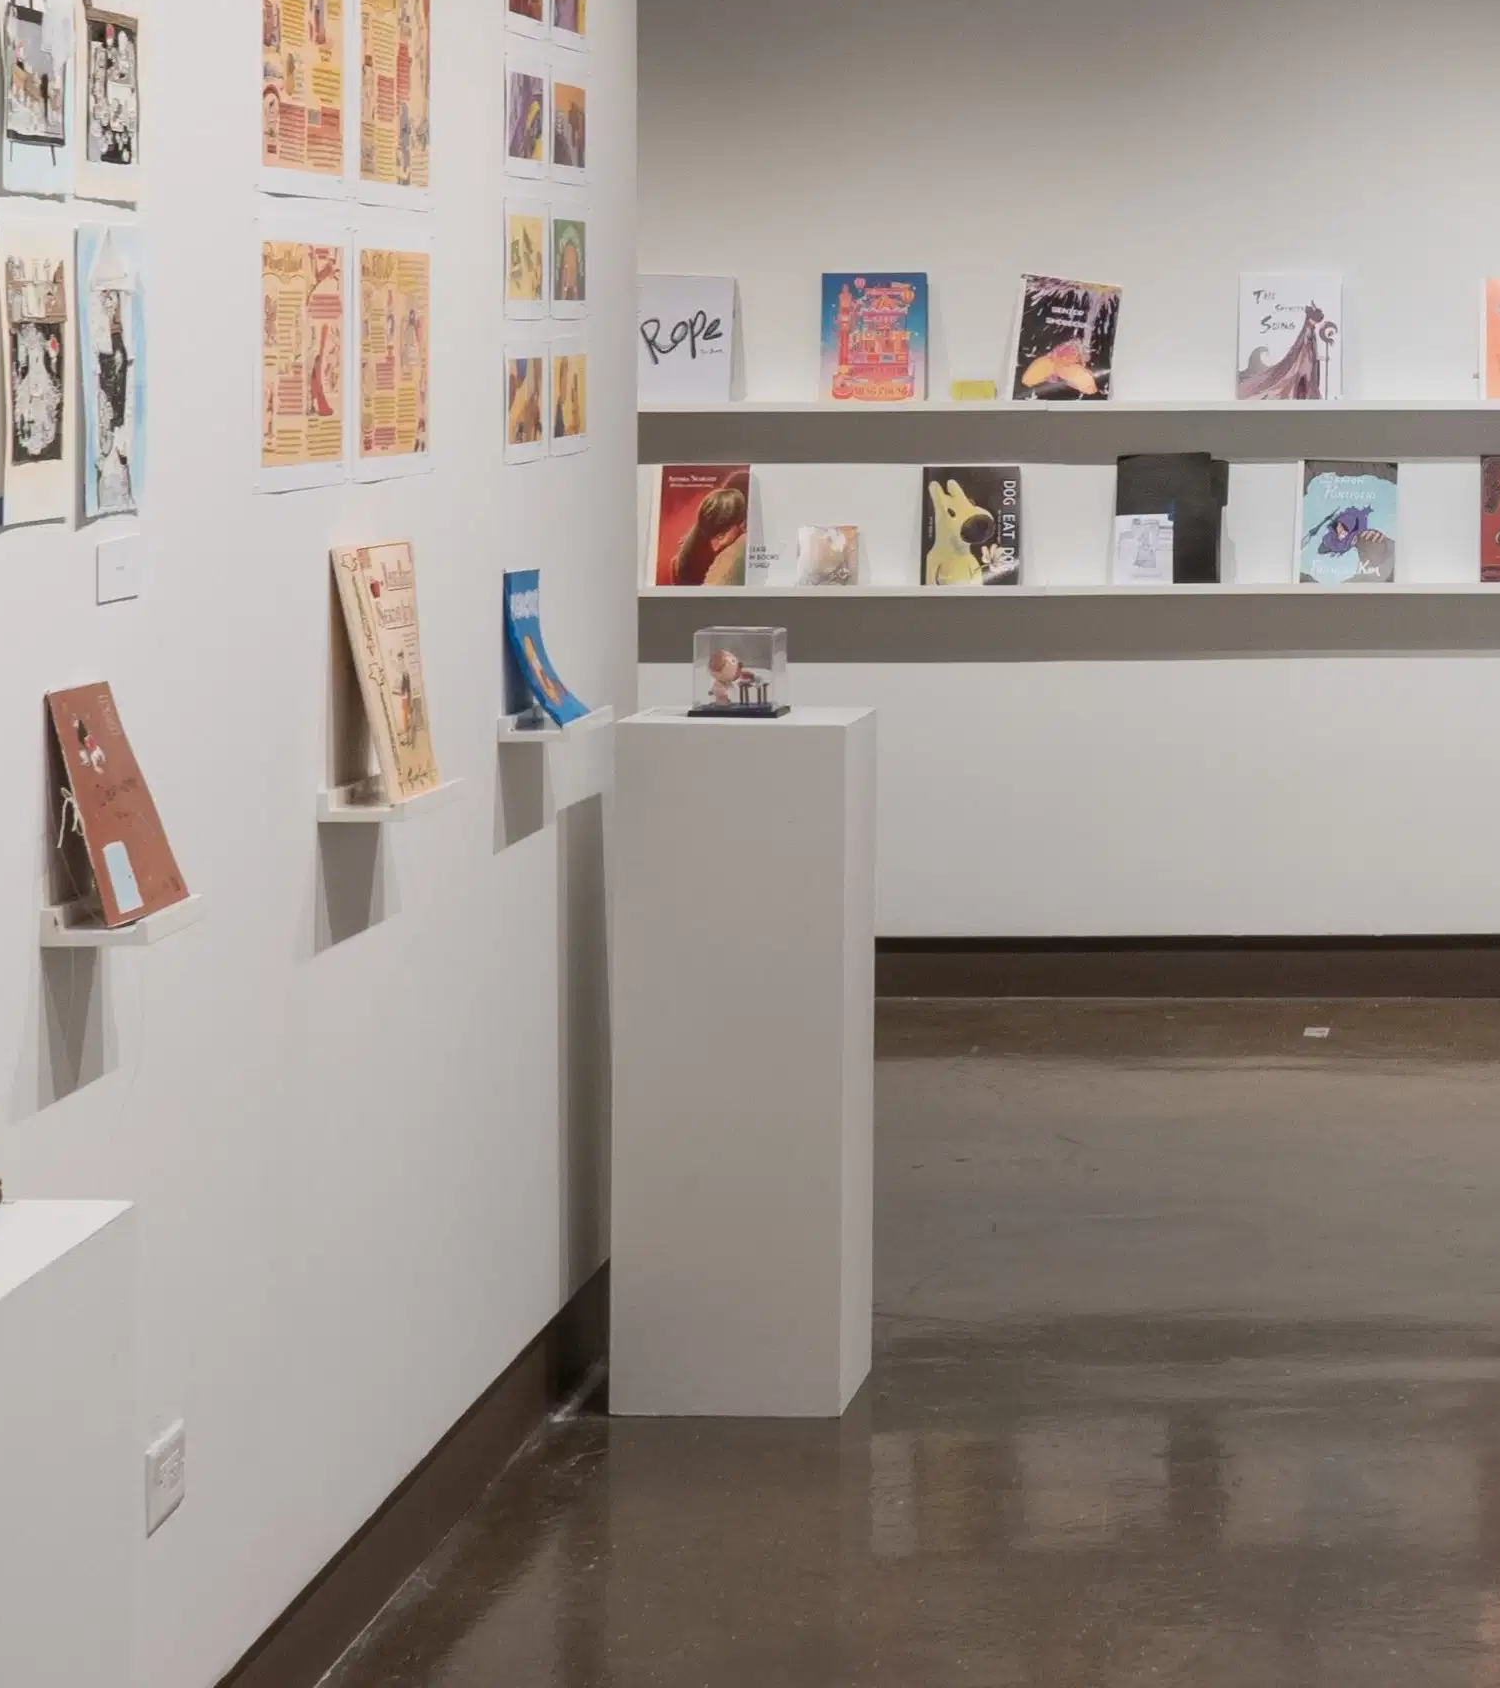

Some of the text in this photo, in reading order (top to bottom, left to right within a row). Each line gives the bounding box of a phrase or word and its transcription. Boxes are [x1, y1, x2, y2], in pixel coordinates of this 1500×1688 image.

[640, 309, 723, 365] Rope
[1002, 479, 1017, 506] DOG
[1002, 514, 1017, 540] EAT
